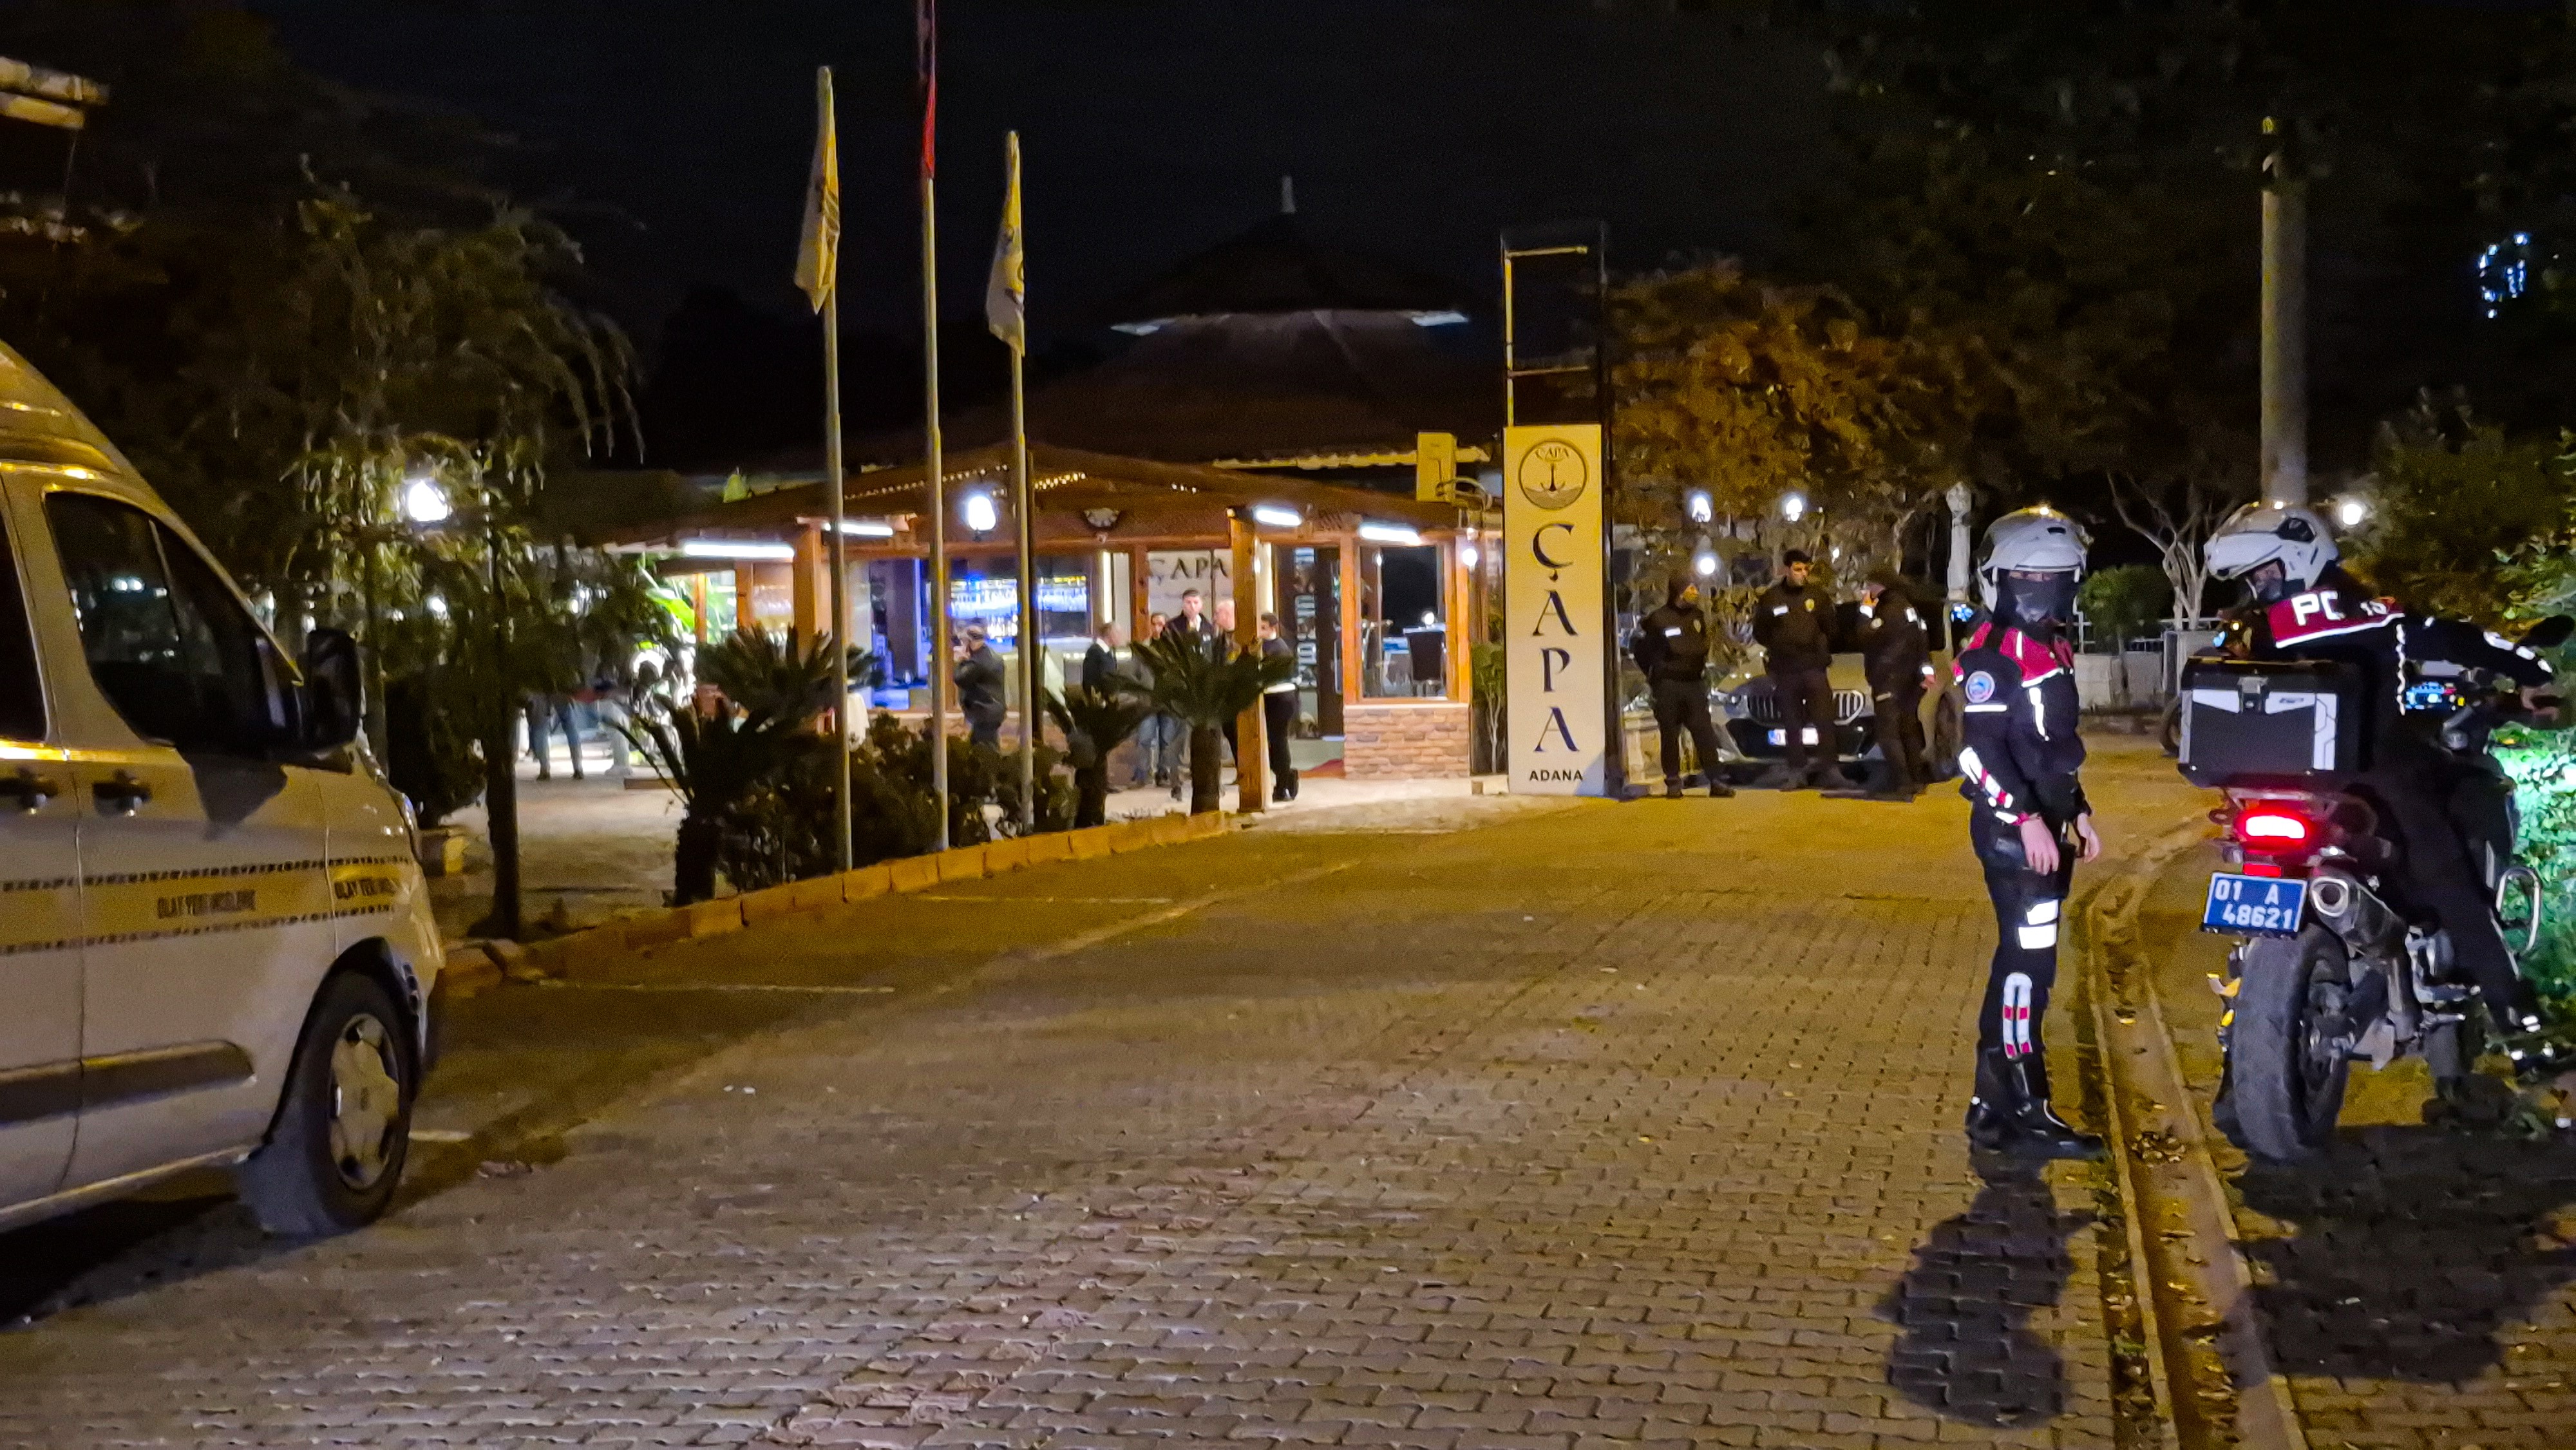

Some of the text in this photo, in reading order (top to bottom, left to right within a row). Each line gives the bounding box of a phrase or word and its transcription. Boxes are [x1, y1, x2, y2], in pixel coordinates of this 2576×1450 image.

[1529, 769, 1584, 782] ADANA
[2215, 880, 2279, 905] 01 A
[2222, 903, 2293, 930] 48621
